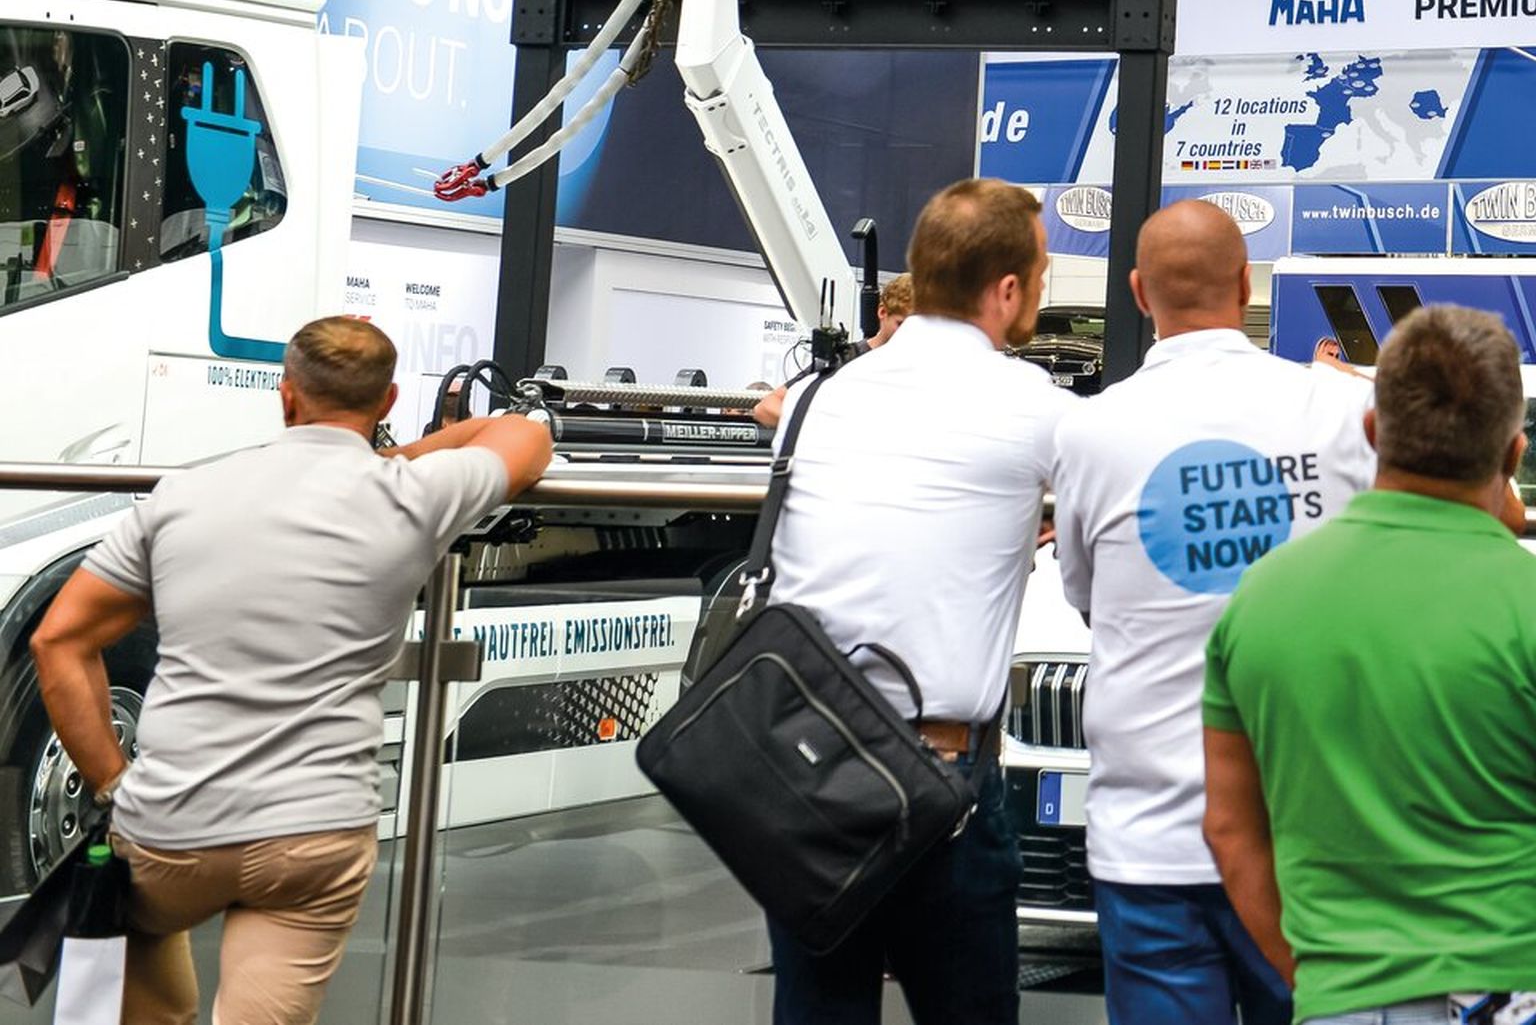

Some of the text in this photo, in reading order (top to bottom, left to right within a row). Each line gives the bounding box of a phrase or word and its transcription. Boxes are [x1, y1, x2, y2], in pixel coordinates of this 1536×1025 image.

[1214, 97, 1308, 115] 12 locations
[1231, 119, 1247, 136] in
[1176, 139, 1263, 157] 7 countries
[1473, 180, 1520, 220] TWIN
[1302, 204, 1440, 220] www.twinbusch.de
[347, 276, 371, 289] MAHA
[405, 283, 441, 297] WELCOME
[207, 365, 232, 387] 100%
[666, 424, 757, 441] MEILLER-KIPPER
[1179, 453, 1320, 495] FUTURE
[1184, 491, 1323, 533] STARTS
[1186, 534, 1273, 573] NOW
[565, 614, 675, 655] EMISSIONSFREI.
[1045, 803, 1054, 815] D
